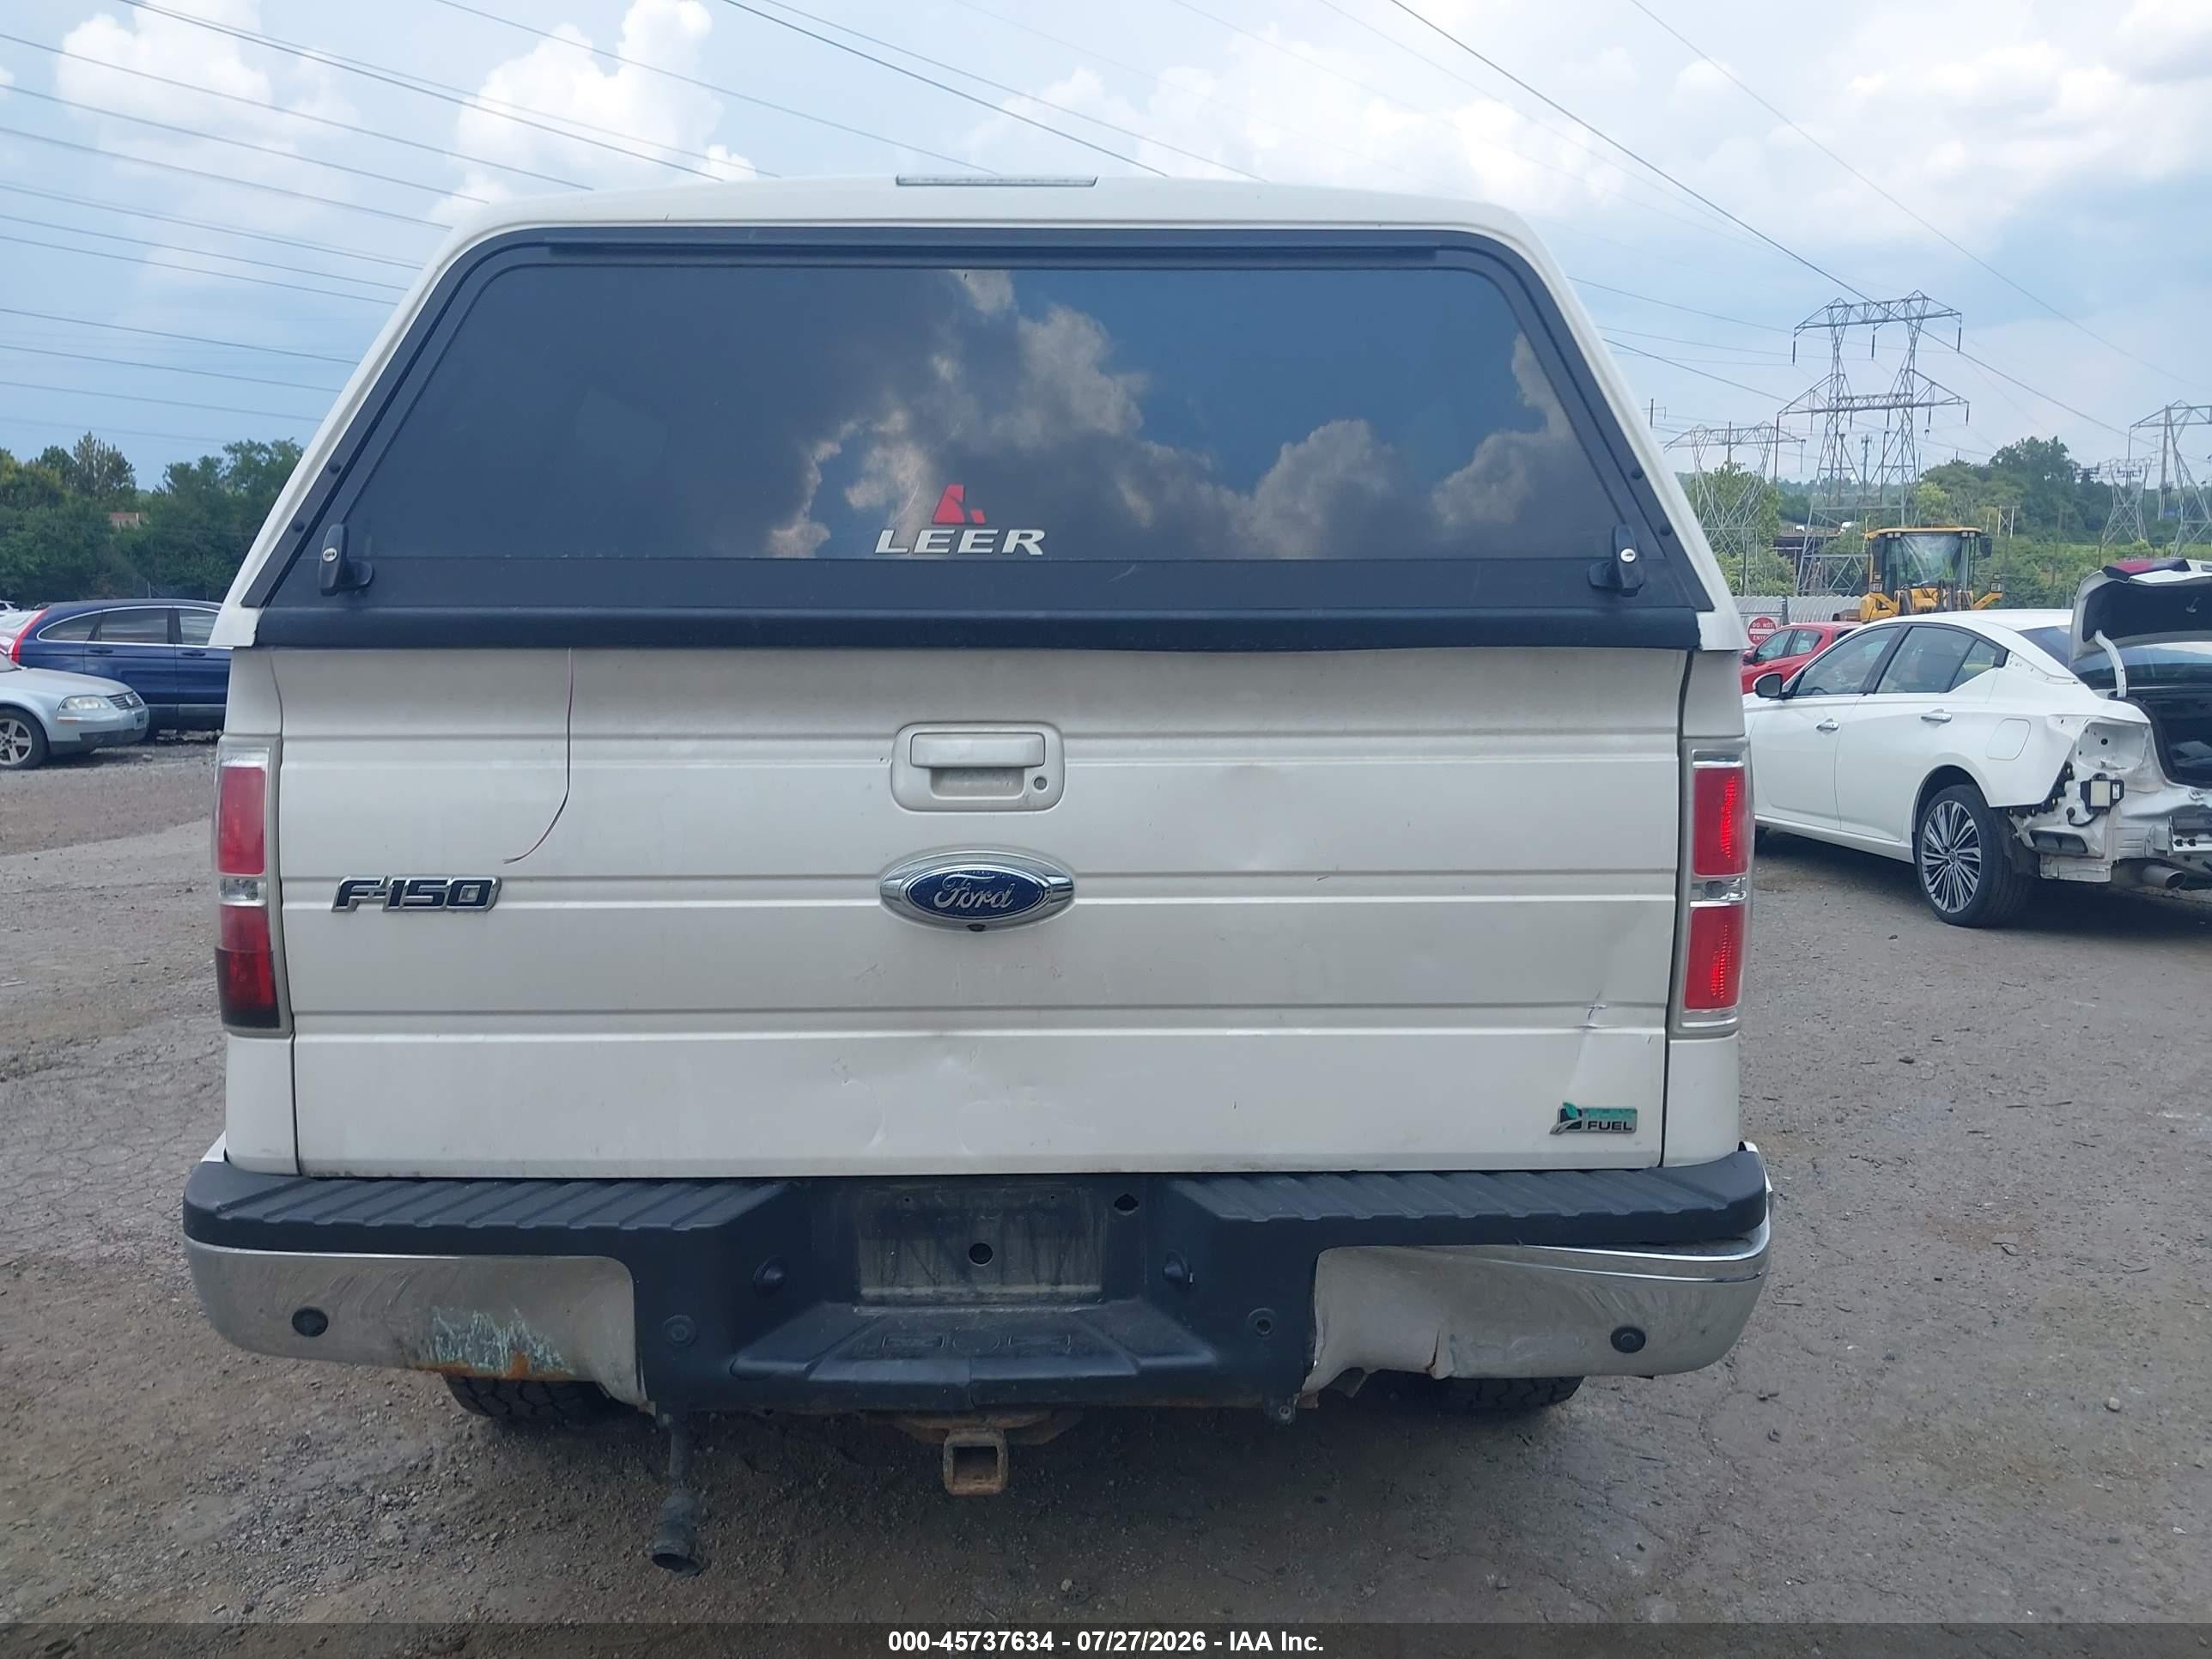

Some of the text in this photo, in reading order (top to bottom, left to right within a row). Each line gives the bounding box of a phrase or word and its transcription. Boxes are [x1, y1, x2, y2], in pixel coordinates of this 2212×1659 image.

[874, 528, 1047, 556] LEER
[331, 875, 502, 914] F-150
[933, 873, 1017, 909] Ford
[1587, 1120, 1632, 1131] FUEL
